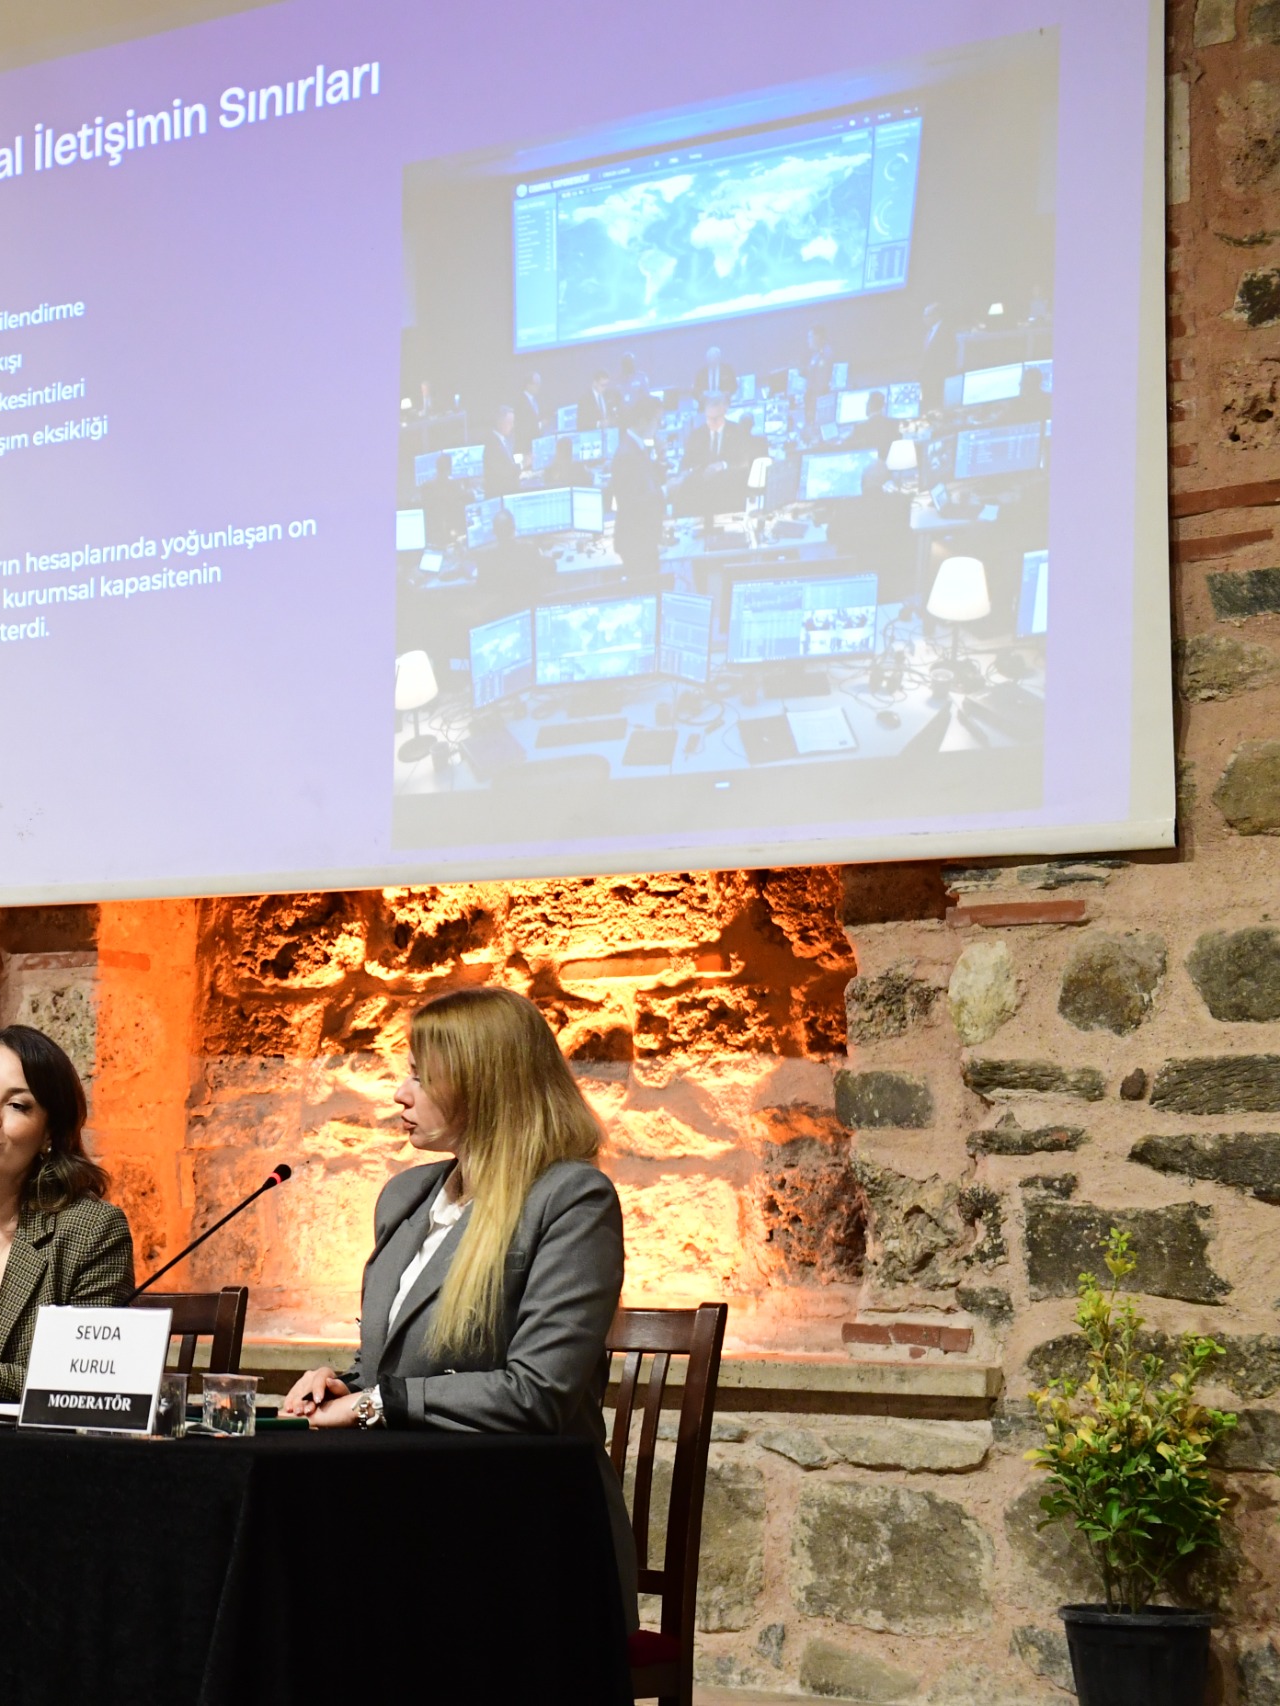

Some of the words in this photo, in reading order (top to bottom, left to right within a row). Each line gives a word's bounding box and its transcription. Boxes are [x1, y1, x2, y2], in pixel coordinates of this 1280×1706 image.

[34, 98, 207, 171] İletişimin
[219, 61, 381, 129] Sınırları
[33, 415, 109, 446] eksikliği
[25, 537, 157, 573] hesaplarında
[161, 522, 283, 561] yoğunlaşan
[288, 518, 317, 539] on
[2, 578, 95, 610] kurumsal
[100, 563, 222, 599] kapasitenin
[75, 1325, 121, 1341] SEVDA
[70, 1358, 116, 1375] KURUL
[48, 1393, 132, 1412] MODERATÖR
